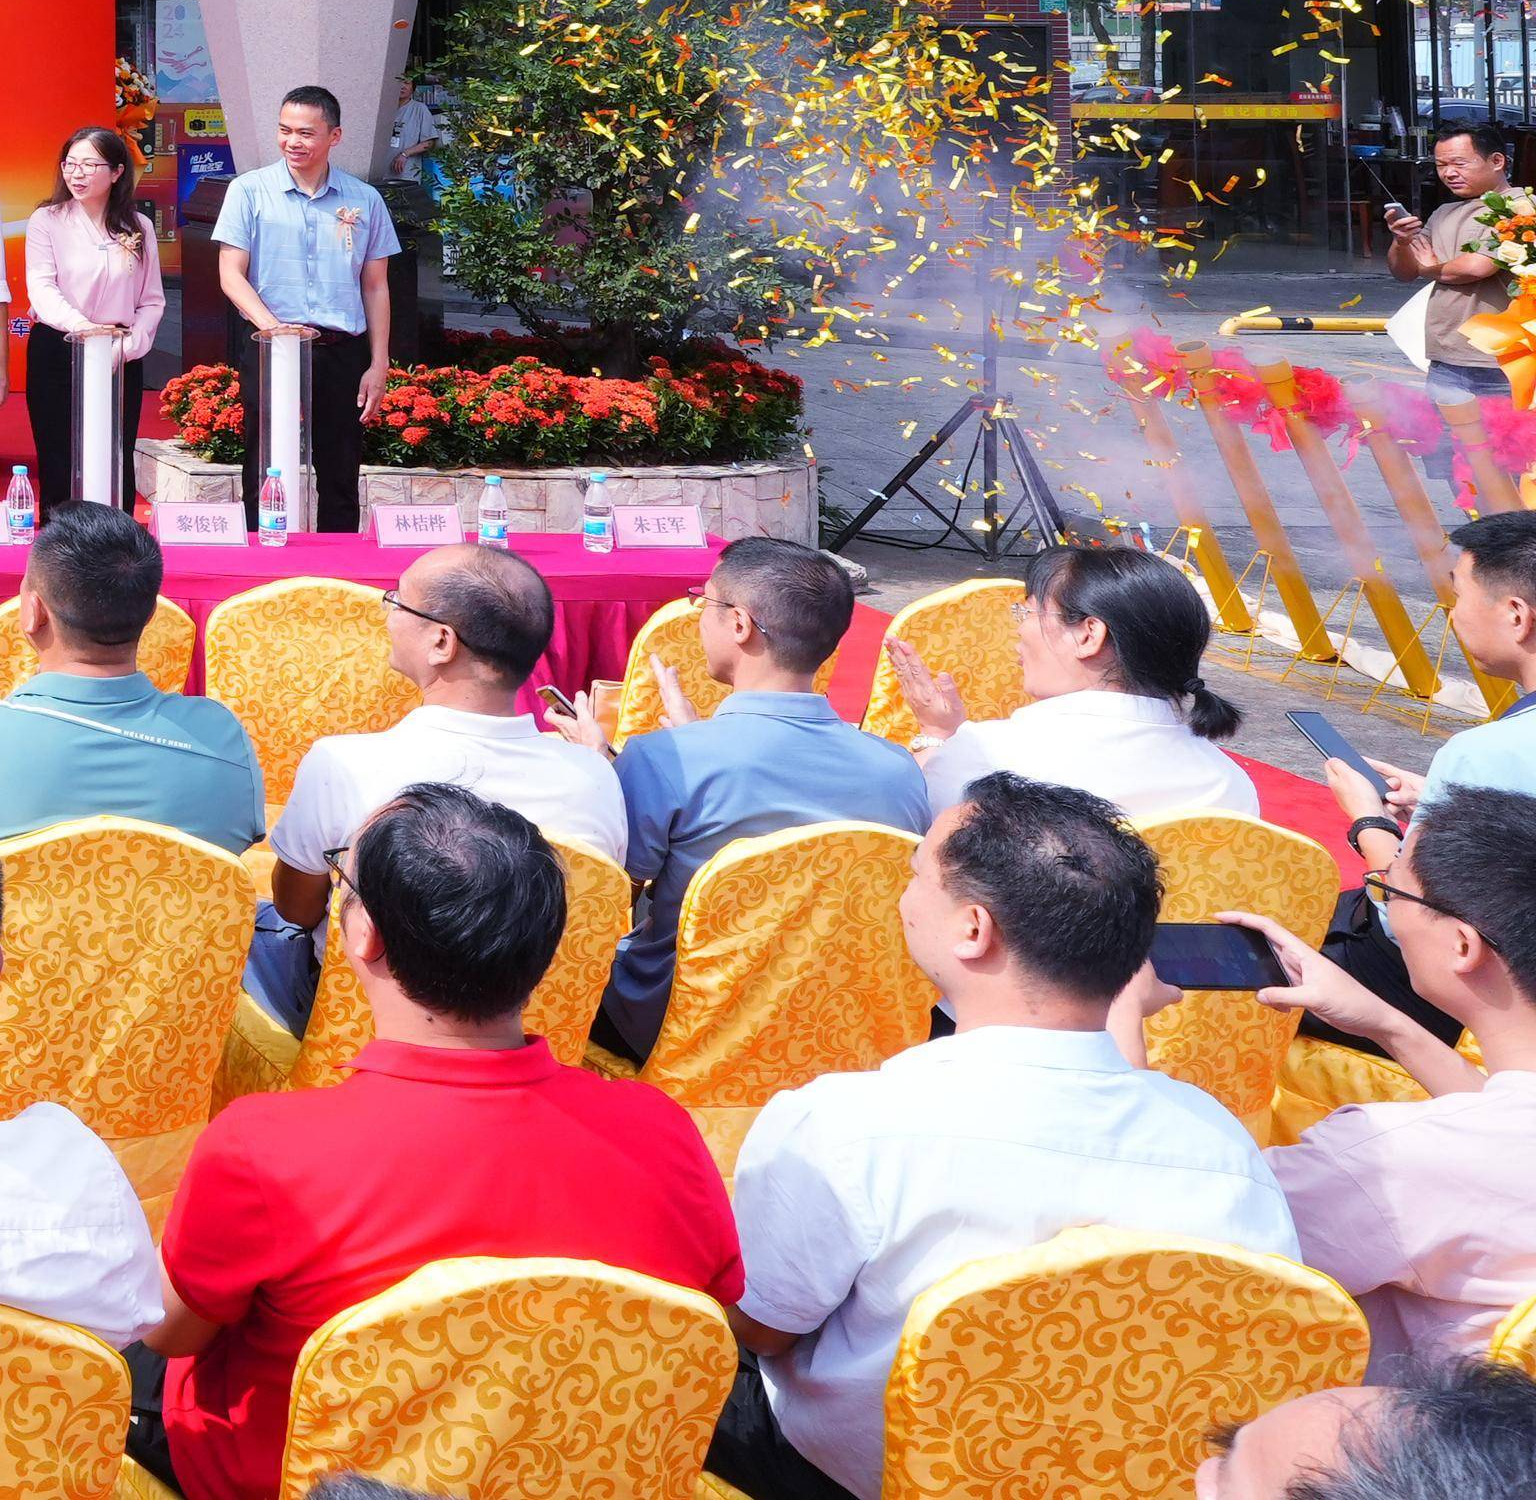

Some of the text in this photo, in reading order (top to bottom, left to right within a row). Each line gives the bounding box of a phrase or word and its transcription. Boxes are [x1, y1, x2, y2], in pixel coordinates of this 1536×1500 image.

[394, 514, 448, 532] 林桔桦
[633, 515, 687, 535] 朱玉军
